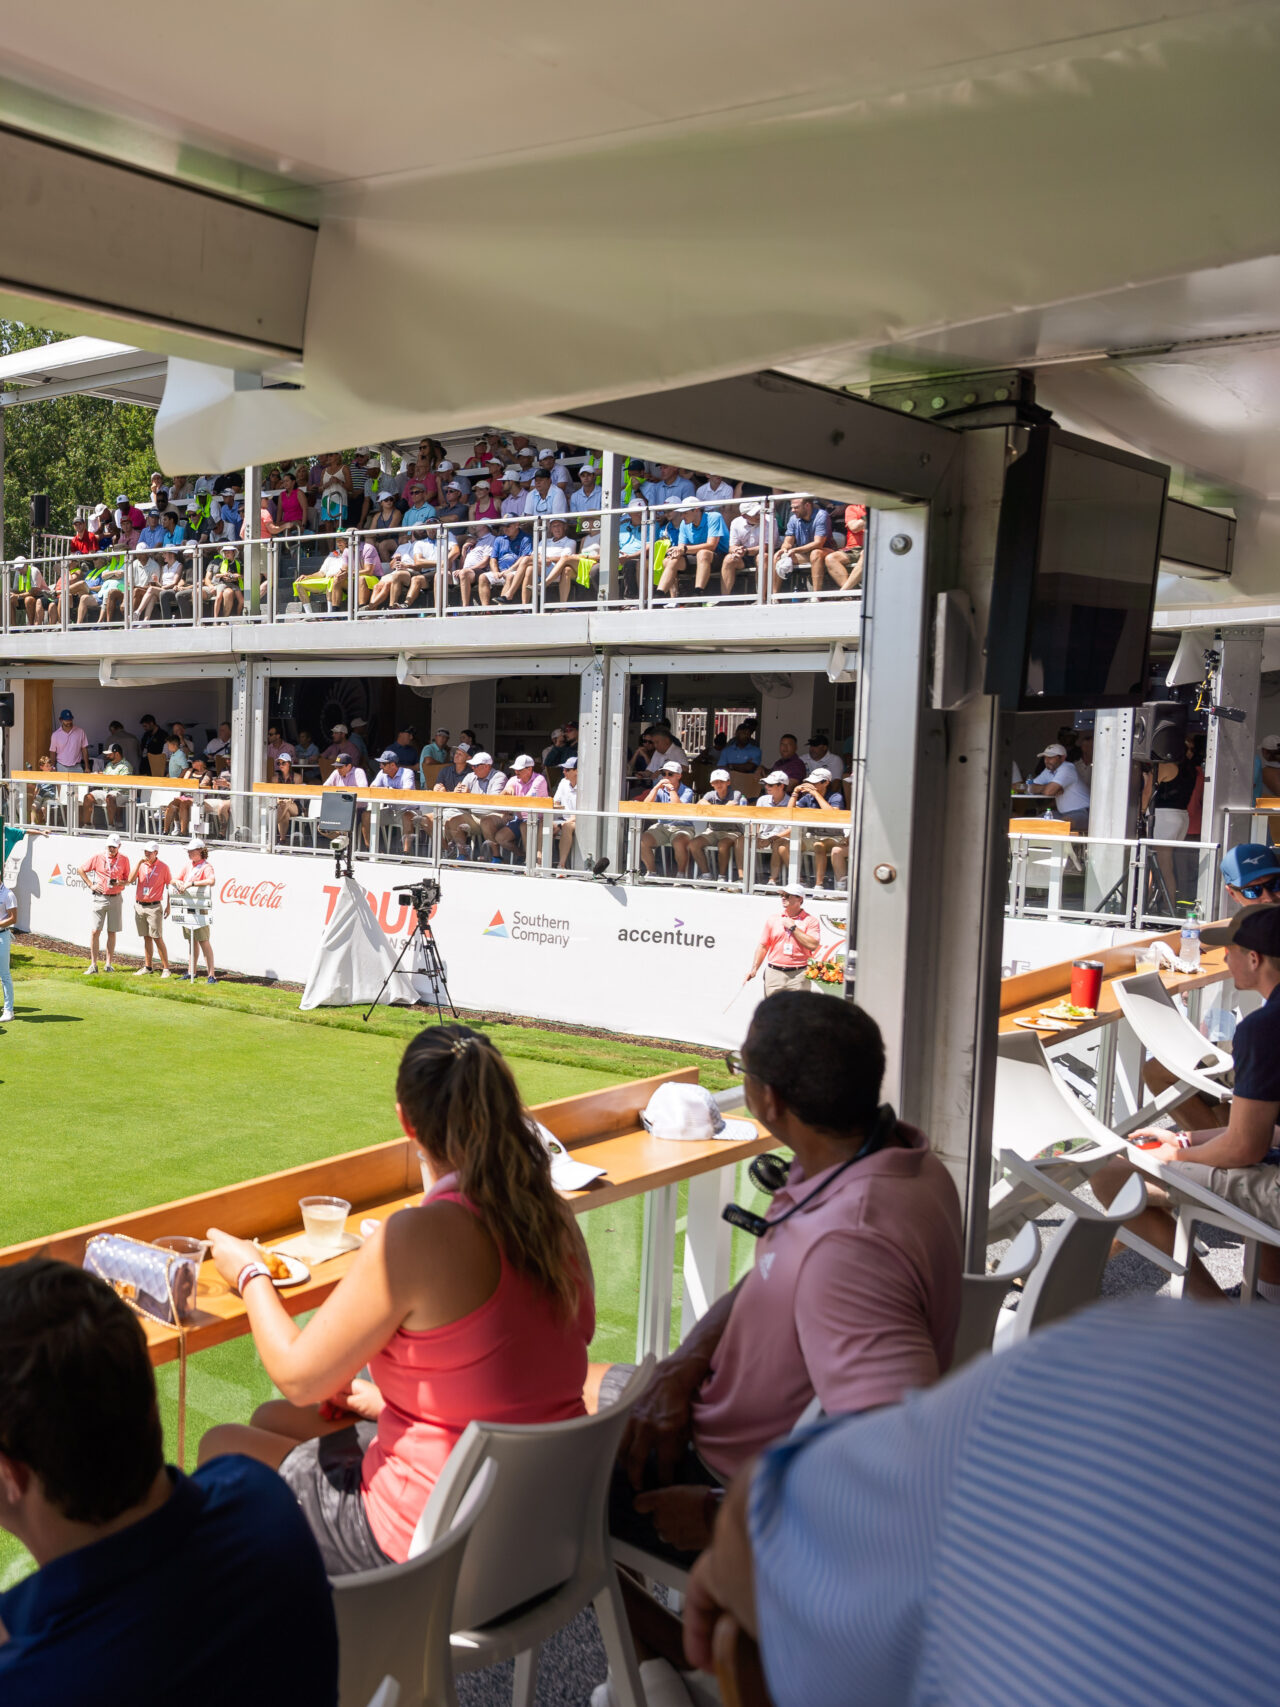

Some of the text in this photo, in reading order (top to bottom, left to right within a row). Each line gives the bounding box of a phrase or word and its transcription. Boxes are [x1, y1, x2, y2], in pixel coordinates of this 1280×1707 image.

[220, 877, 287, 909] Coca-Cola
[512, 911, 570, 930] Southern
[511, 926, 570, 948] Company
[618, 928, 716, 949] accenture
